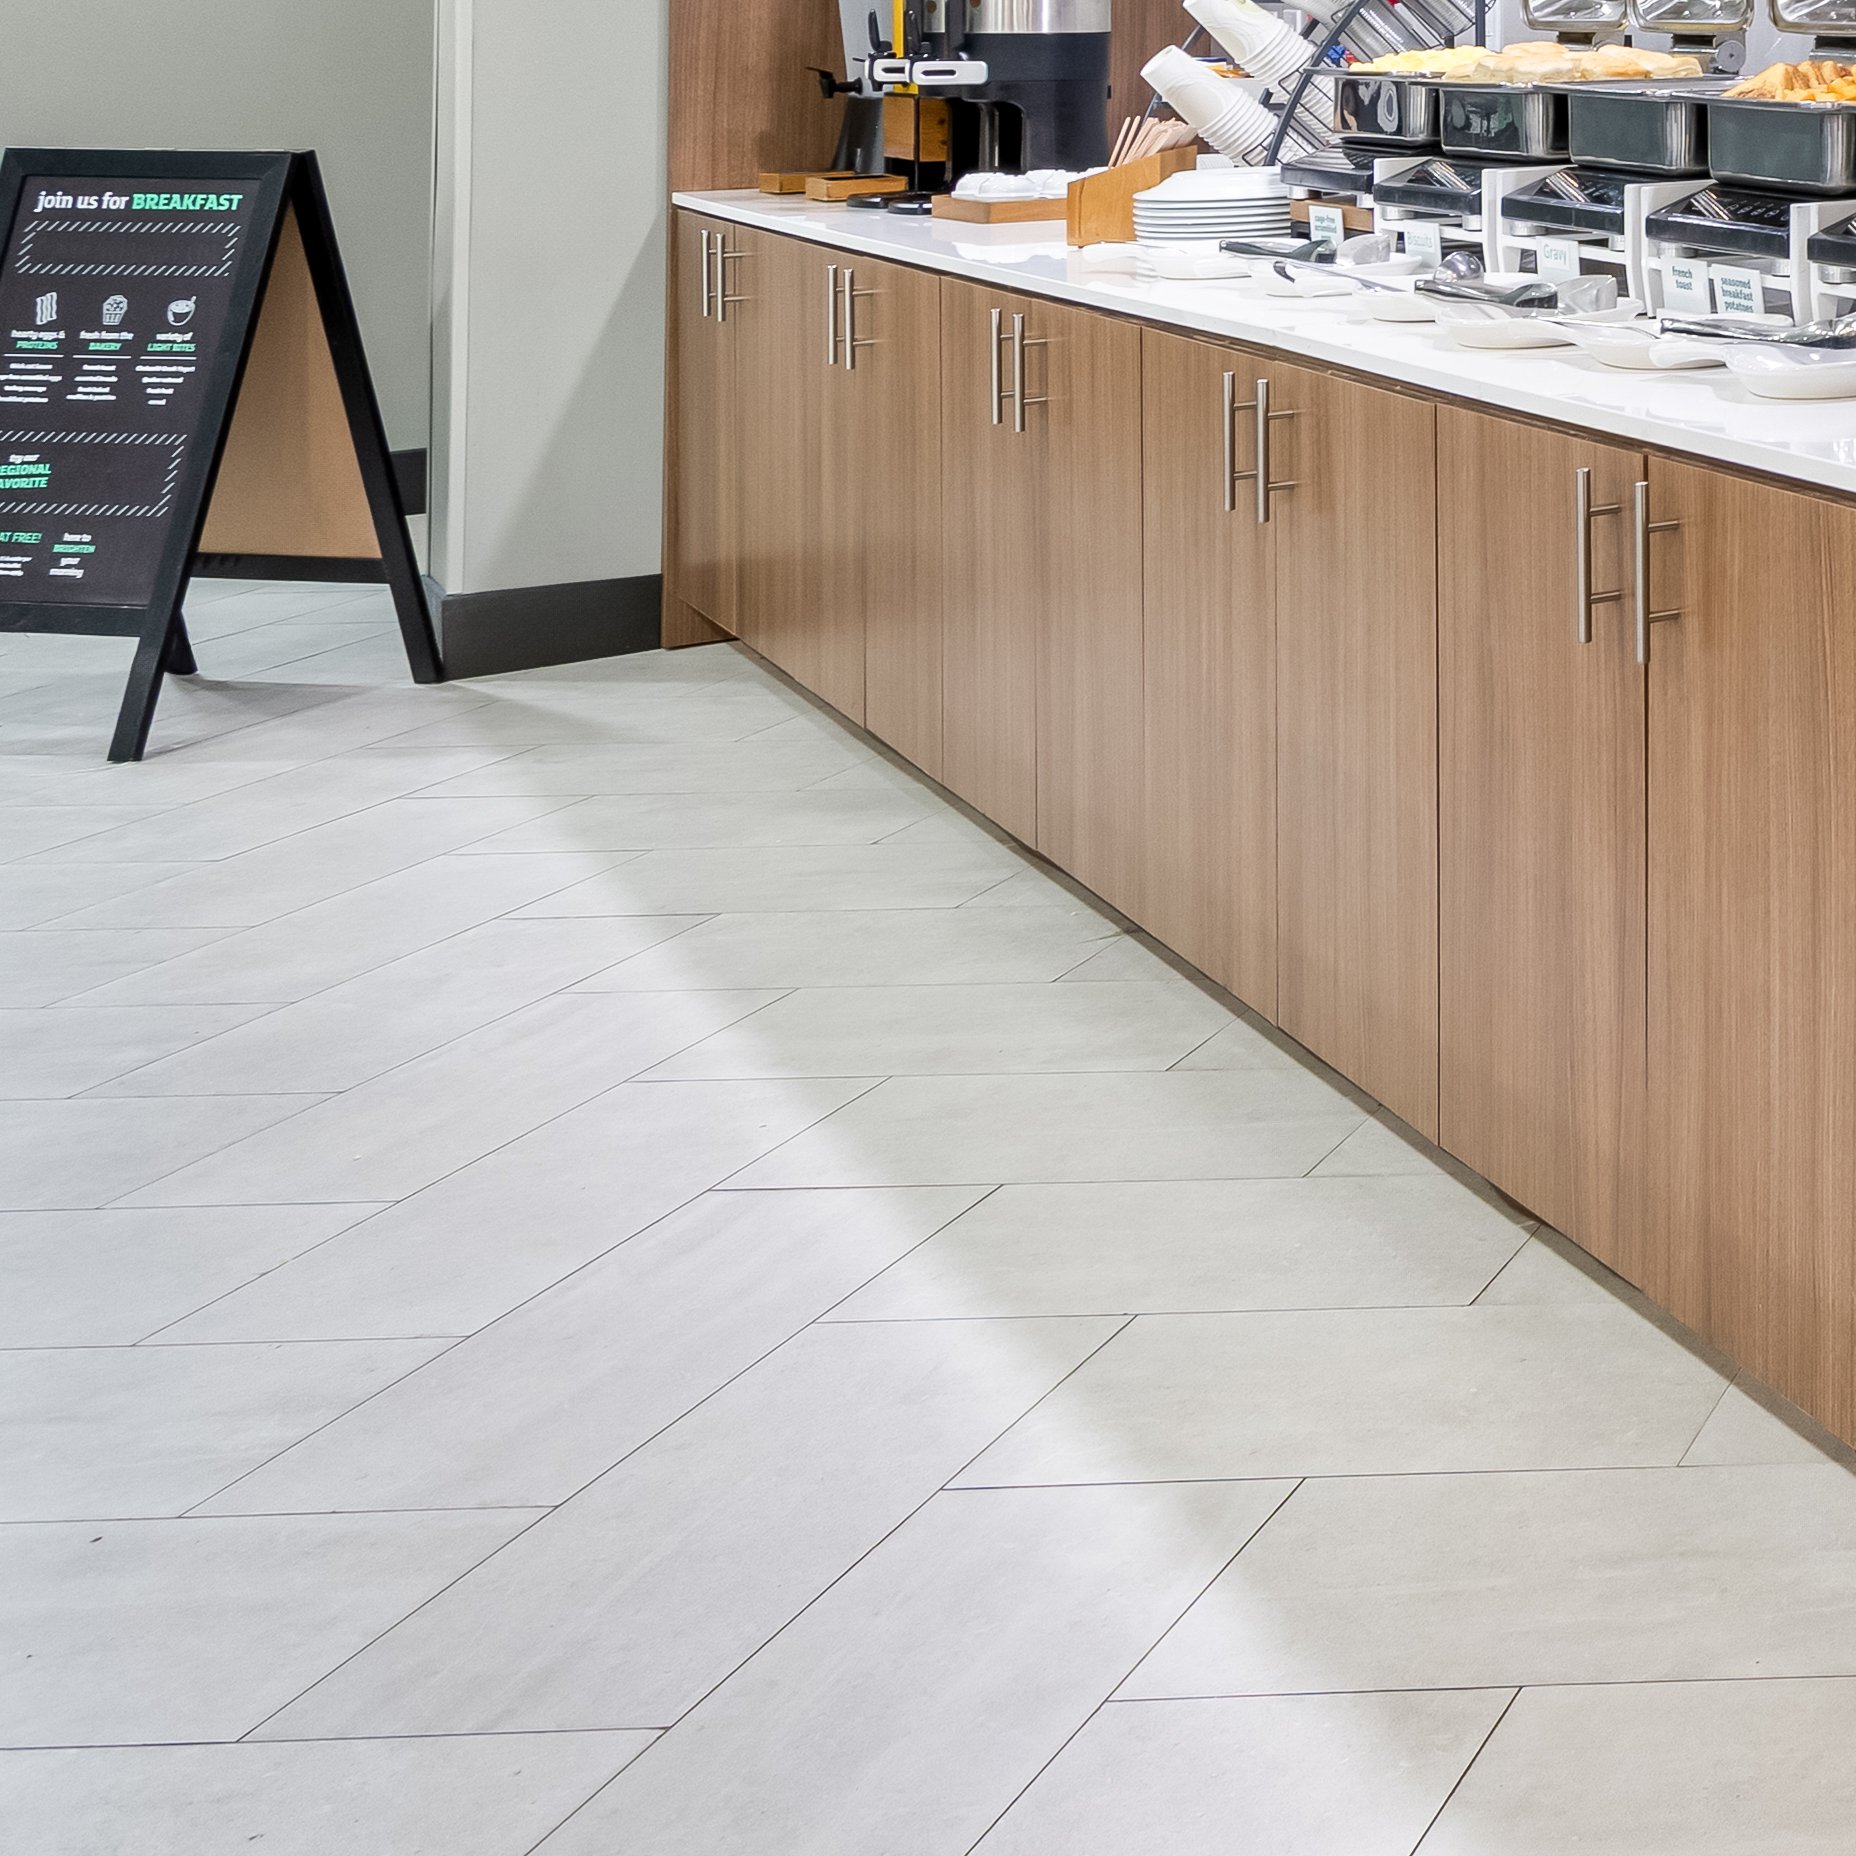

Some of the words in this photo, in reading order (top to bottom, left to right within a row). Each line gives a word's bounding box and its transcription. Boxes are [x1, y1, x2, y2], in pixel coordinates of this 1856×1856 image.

[33, 191, 73, 213] join
[75, 195, 99, 210] us
[101, 192, 130, 210] for
[131, 193, 244, 211] BREAKFAST
[1543, 243, 1568, 265] Gravy
[1672, 265, 1693, 280] french
[1675, 279, 1693, 291] toast
[1720, 275, 1752, 289] seasoned
[1721, 285, 1754, 302] breakfast
[0, 463, 52, 476] EGIONAL
[0, 476, 49, 489] AVORITE
